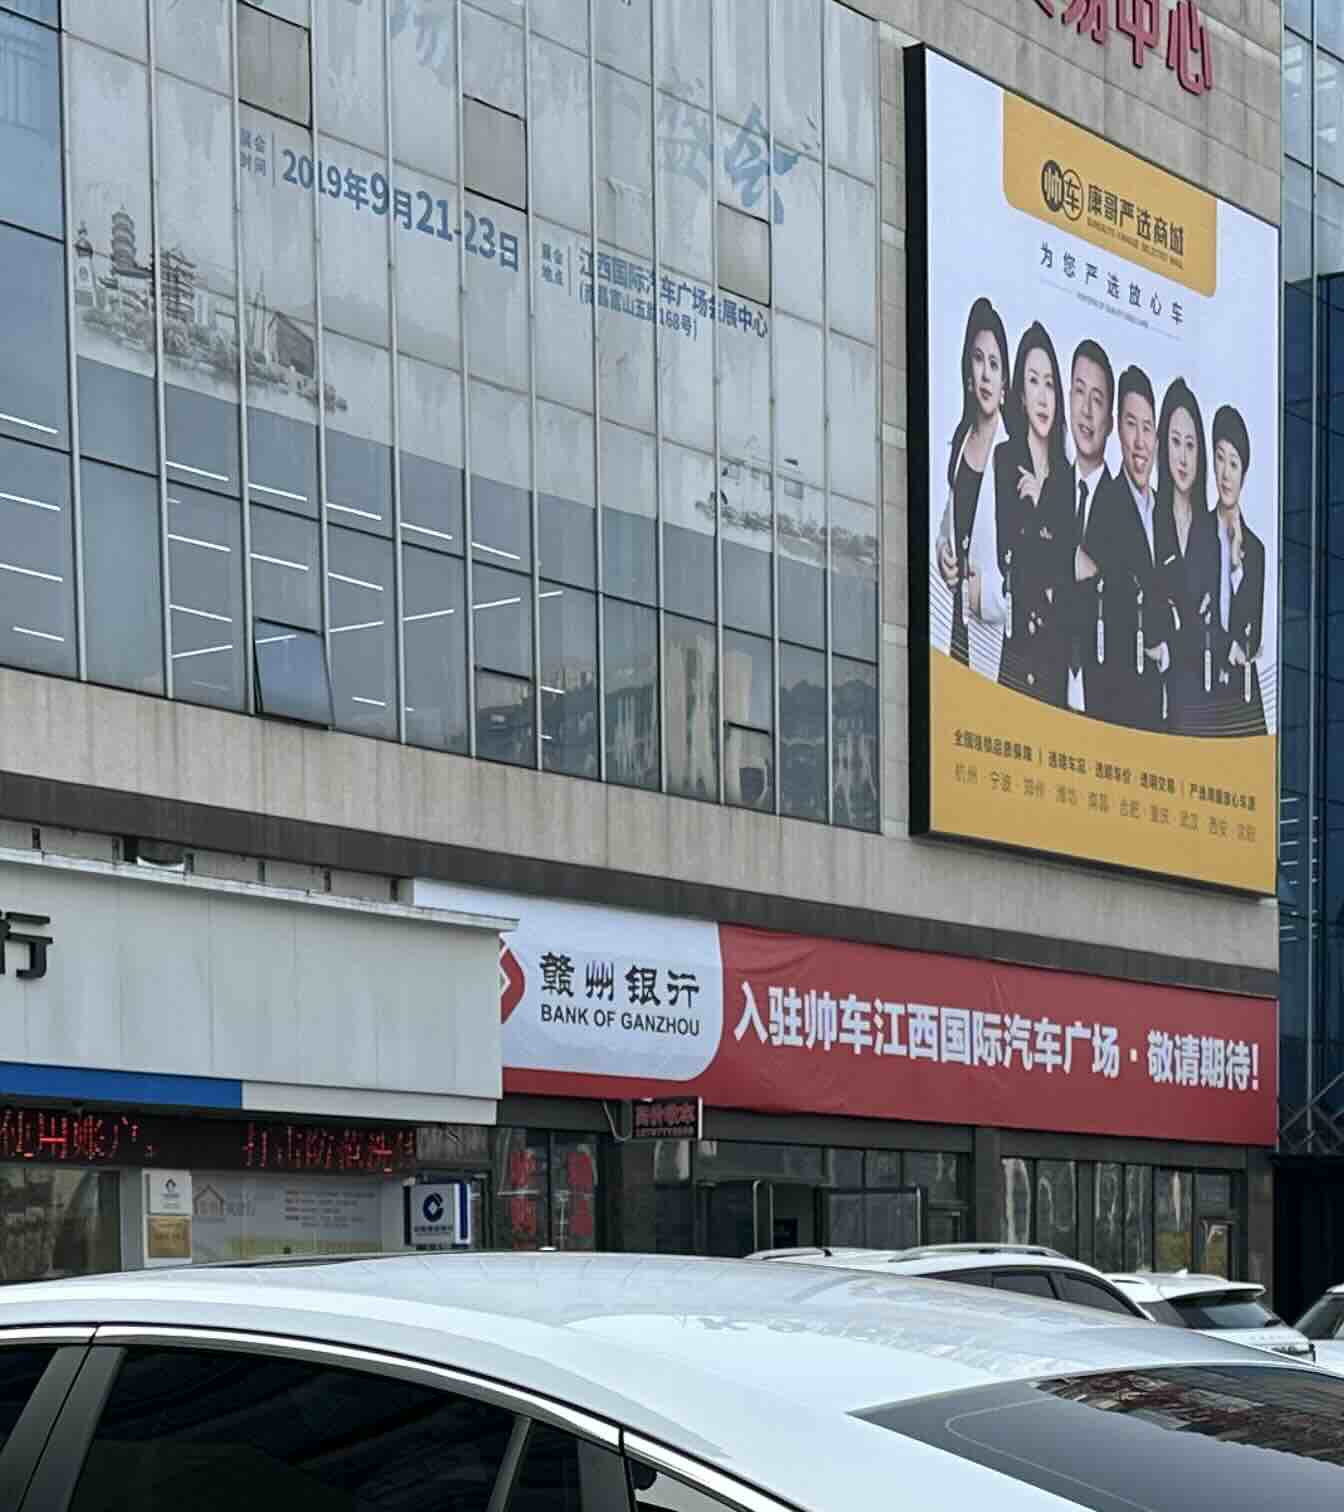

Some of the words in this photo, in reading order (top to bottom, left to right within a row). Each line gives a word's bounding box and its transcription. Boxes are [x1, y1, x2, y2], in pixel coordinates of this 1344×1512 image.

[539, 950, 700, 1011] 赣州银行
[540, 1002, 588, 1028] BANK
[592, 1007, 617, 1029] OF
[620, 1010, 700, 1038] GANZHOU
